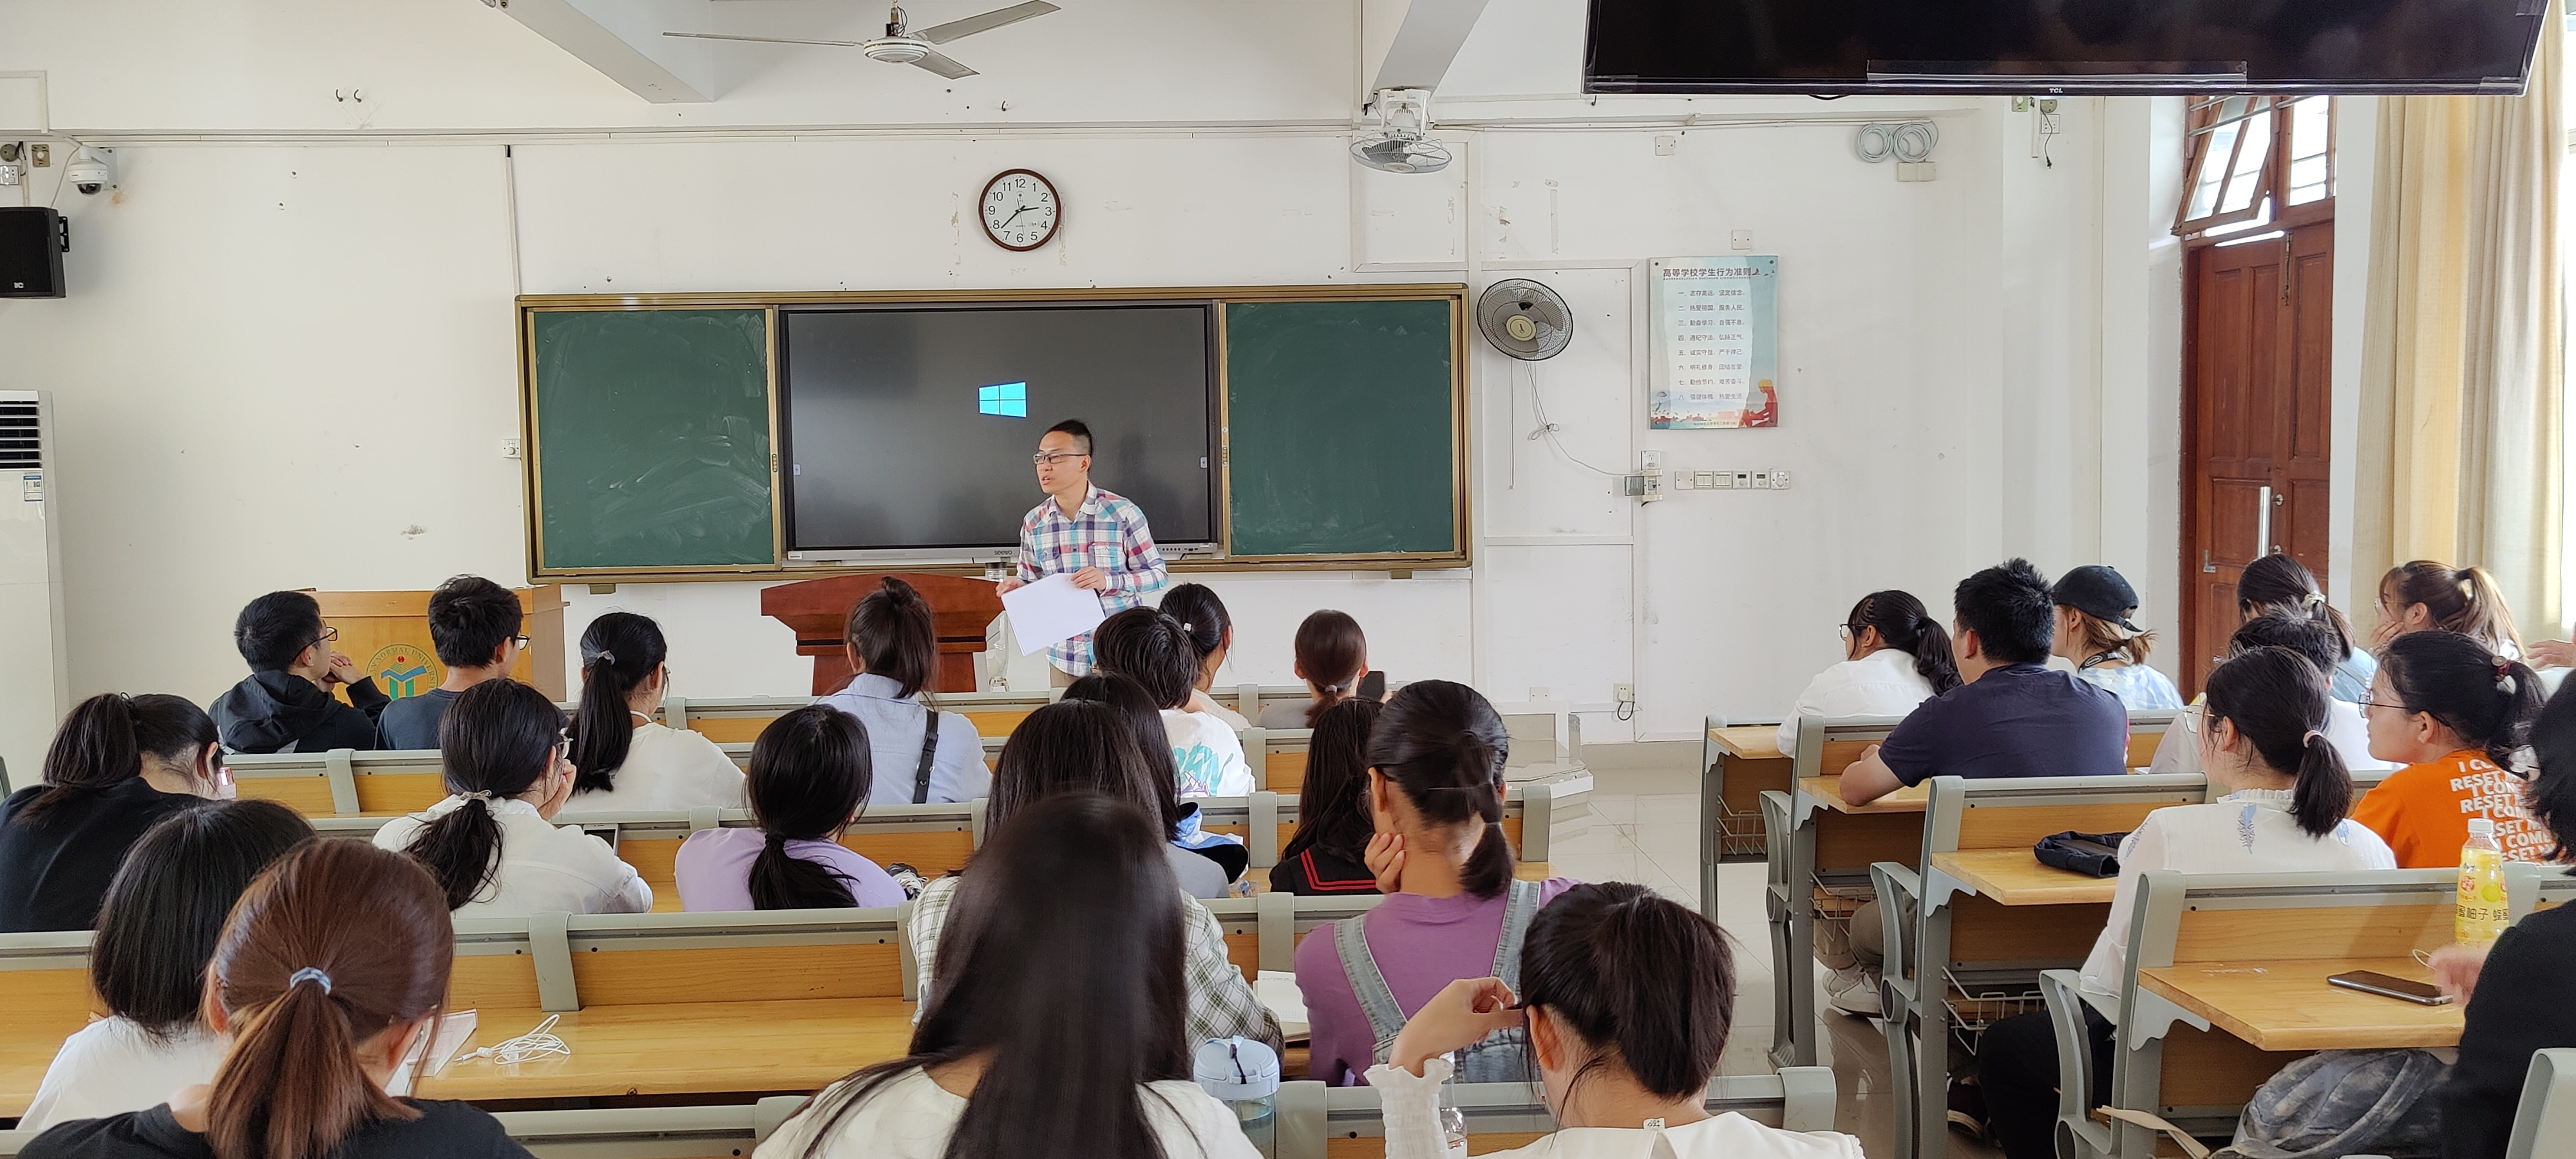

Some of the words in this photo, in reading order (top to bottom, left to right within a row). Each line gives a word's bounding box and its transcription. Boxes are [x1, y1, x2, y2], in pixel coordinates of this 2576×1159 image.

[1003, 182, 1011, 191] 11
[1015, 178, 1025, 188] 12
[1032, 183, 1036, 192] 1
[992, 192, 1003, 201] 10
[1041, 193, 1048, 202] 2
[989, 205, 996, 215] 9
[1045, 207, 1052, 216] 3
[993, 220, 999, 229] 8
[1041, 221, 1048, 230] 4
[1003, 231, 1010, 240] 7
[1017, 233, 1023, 243] 6
[1031, 232, 1037, 240] 5
[1663, 267, 1751, 277] 高等学校学生行为准则
[375, 647, 410, 662] NORMAL
[412, 649, 435, 688] UNIVERSIT
[2458, 761, 2466, 772] I
[2450, 771, 2501, 792] RESET
[2460, 794, 2512, 813] RESET
[2495, 818, 2523, 836] SET
[2456, 903, 2488, 920] 蜜柚子
